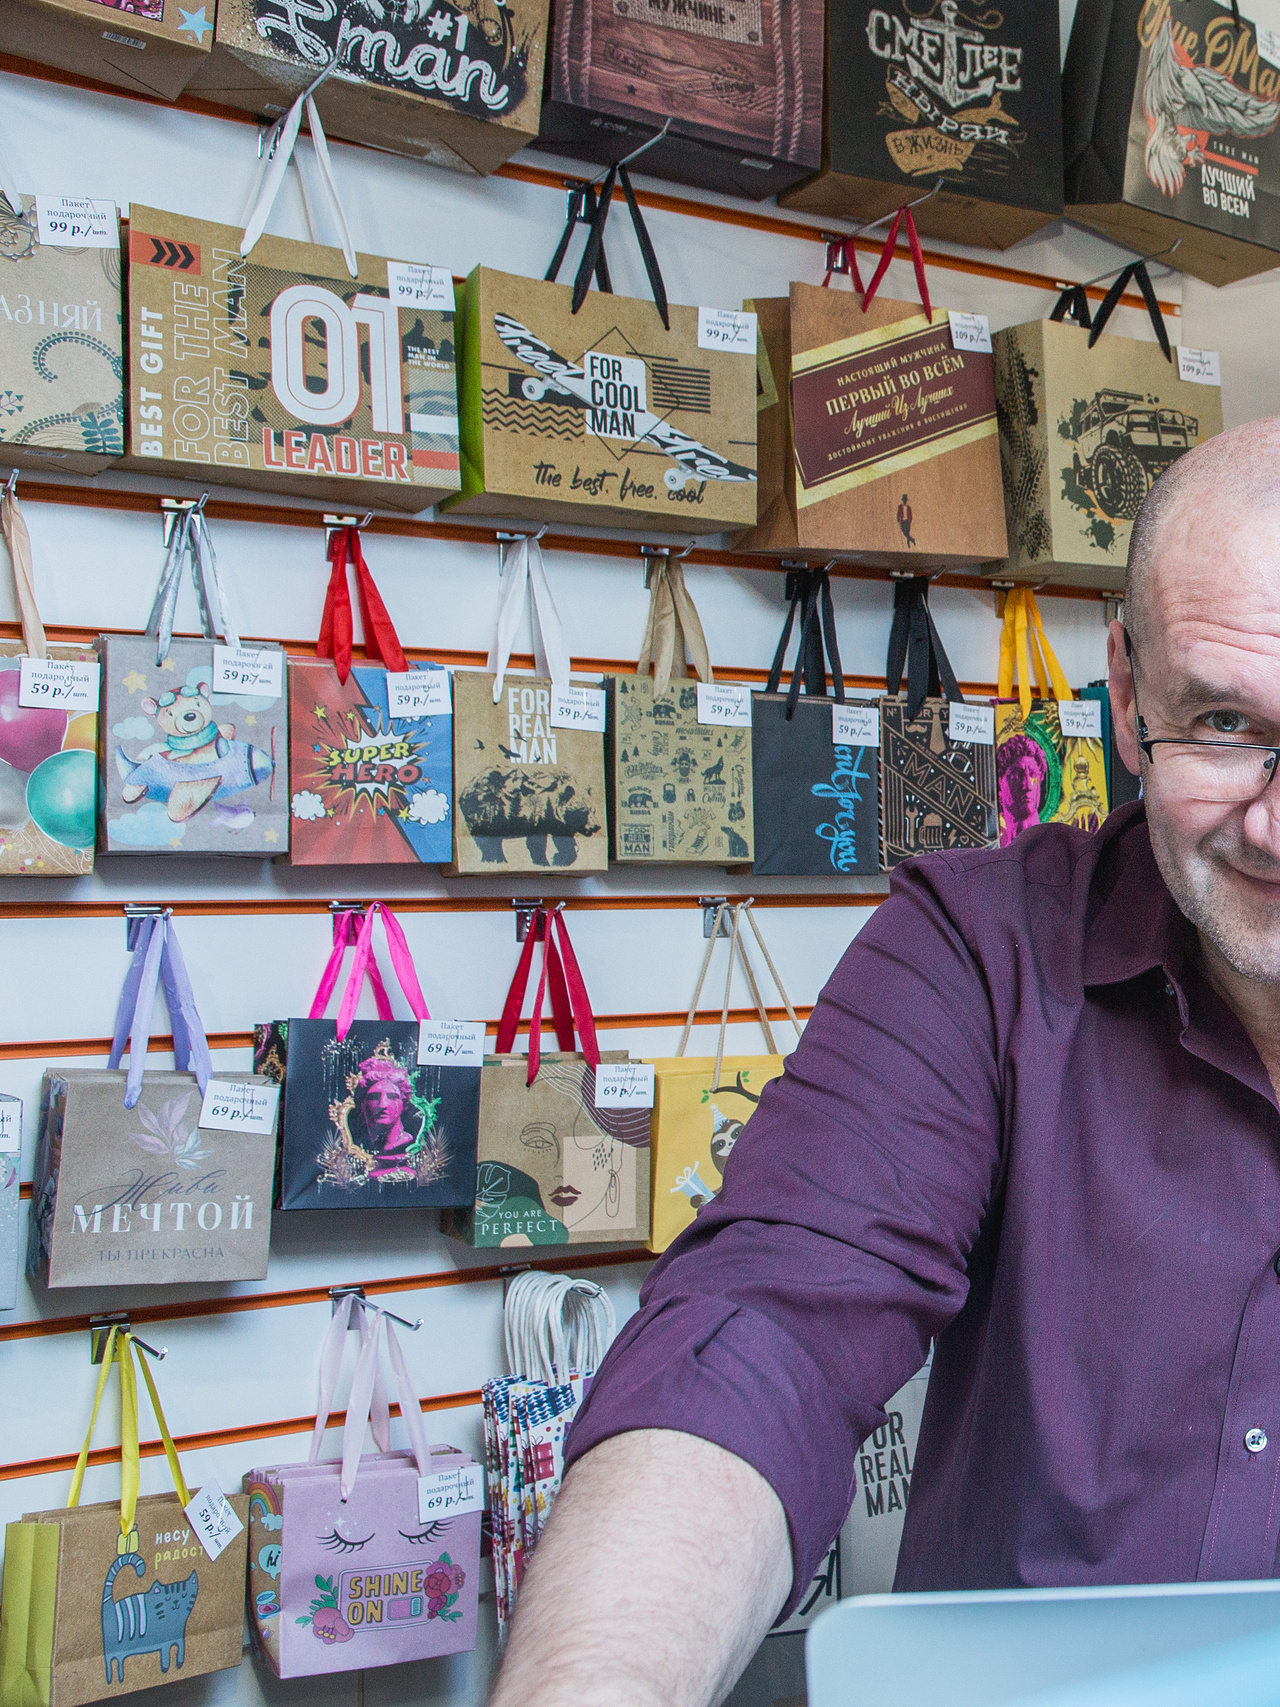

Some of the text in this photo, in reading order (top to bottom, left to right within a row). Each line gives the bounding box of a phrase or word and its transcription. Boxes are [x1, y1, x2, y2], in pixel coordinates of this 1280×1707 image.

[905, 134, 964, 156] ЖИЗНЬ
[1201, 163, 1256, 202] ЛУЧШИЙ
[1202, 186, 1250, 219] ВО ВСЕМ
[49, 221, 68, 234] 99
[398, 285, 413, 296] 99
[706, 328, 720, 338] 99
[955, 330, 968, 341] 109
[212, 247, 250, 468] BEST MAN
[270, 284, 406, 436] 01
[407, 345, 440, 356] THE BEST
[407, 352, 426, 360] MAN
[172, 281, 211, 464] FOR THE
[423, 361, 451, 370] WORLD
[590, 356, 623, 382] FOR
[837, 342, 947, 387] НАСТОЯЩИЙ МУЖЧИНА
[1182, 364, 1194, 373] 109
[140, 306, 164, 457] BEST GIFT
[825, 354, 966, 416] ПЕРВЫЙ ВО ВСЁМ
[591, 379, 647, 413] COOL
[844, 403, 892, 439] Лучший
[909, 386, 955, 414] Лучших
[591, 409, 636, 438] MAN
[262, 427, 412, 483] LEADER
[827, 437, 876, 461] ДОСТОЙНОМУ
[667, 480, 707, 504] cool
[222, 669, 239, 681] 59
[31, 681, 50, 694] 59
[397, 694, 411, 706] 59
[508, 687, 550, 715] FOR
[711, 704, 723, 714] 59
[558, 706, 572, 717] 59
[509, 714, 556, 738] REAL
[838, 724, 849, 734] 59
[954, 721, 965, 732] 59
[1065, 718, 1076, 727] 59
[329, 742, 410, 766] SUPER
[510, 738, 557, 765] MAN
[329, 763, 422, 786] HERO
[902, 751, 974, 818] MAN
[624, 844, 651, 853] MAN
[427, 1042, 443, 1054] 69
[603, 1085, 618, 1097] 69
[210, 1104, 230, 1117] 69
[70, 1195, 255, 1234] МЕЧТОЙ
[498, 1209, 542, 1220] YOU ARE
[481, 1219, 559, 1236] PERFECT
[99, 1247, 225, 1262] ТЫ ПРЕКРАСНА
[859, 1446, 914, 1486] REAL
[427, 1494, 443, 1509] 69
[198, 1508, 212, 1524] 59
[155, 1529, 190, 1546] несу
[154, 1545, 204, 1571] радост
[266, 1550, 281, 1568] hi
[349, 1570, 423, 1599] SHINE
[347, 1600, 383, 1626] ON
